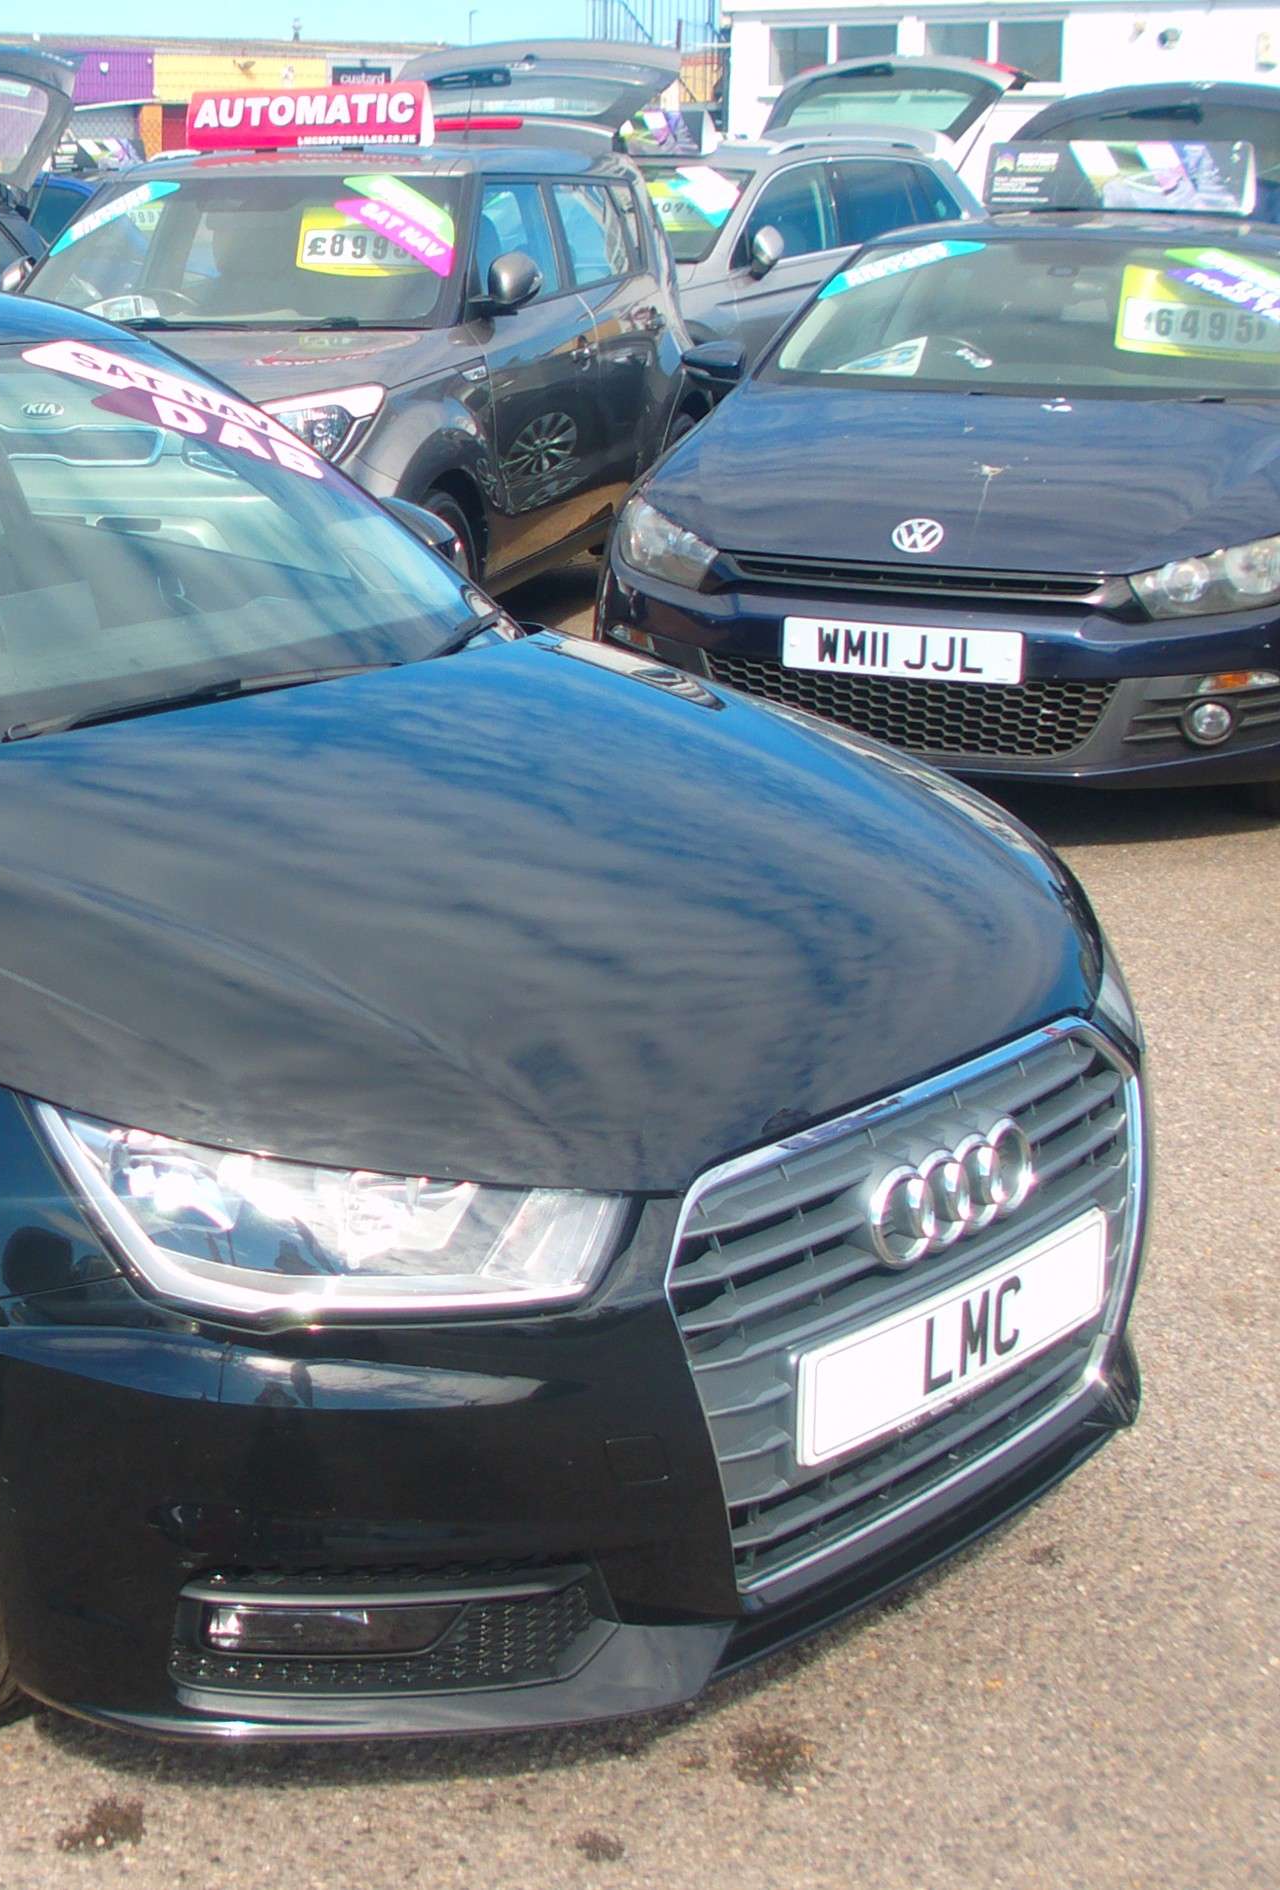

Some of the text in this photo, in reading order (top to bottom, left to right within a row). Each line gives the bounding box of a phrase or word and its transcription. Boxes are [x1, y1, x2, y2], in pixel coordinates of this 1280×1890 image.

[193, 92, 415, 128] AUTOMATIC
[360, 201, 405, 230] SAT
[399, 227, 447, 258] NAV
[24, 403, 59, 416] KIA
[70, 351, 269, 431] SAT NAV
[152, 395, 324, 480] DAB
[816, 626, 983, 674] WM11 JJL
[923, 1275, 1022, 1396] LMC
